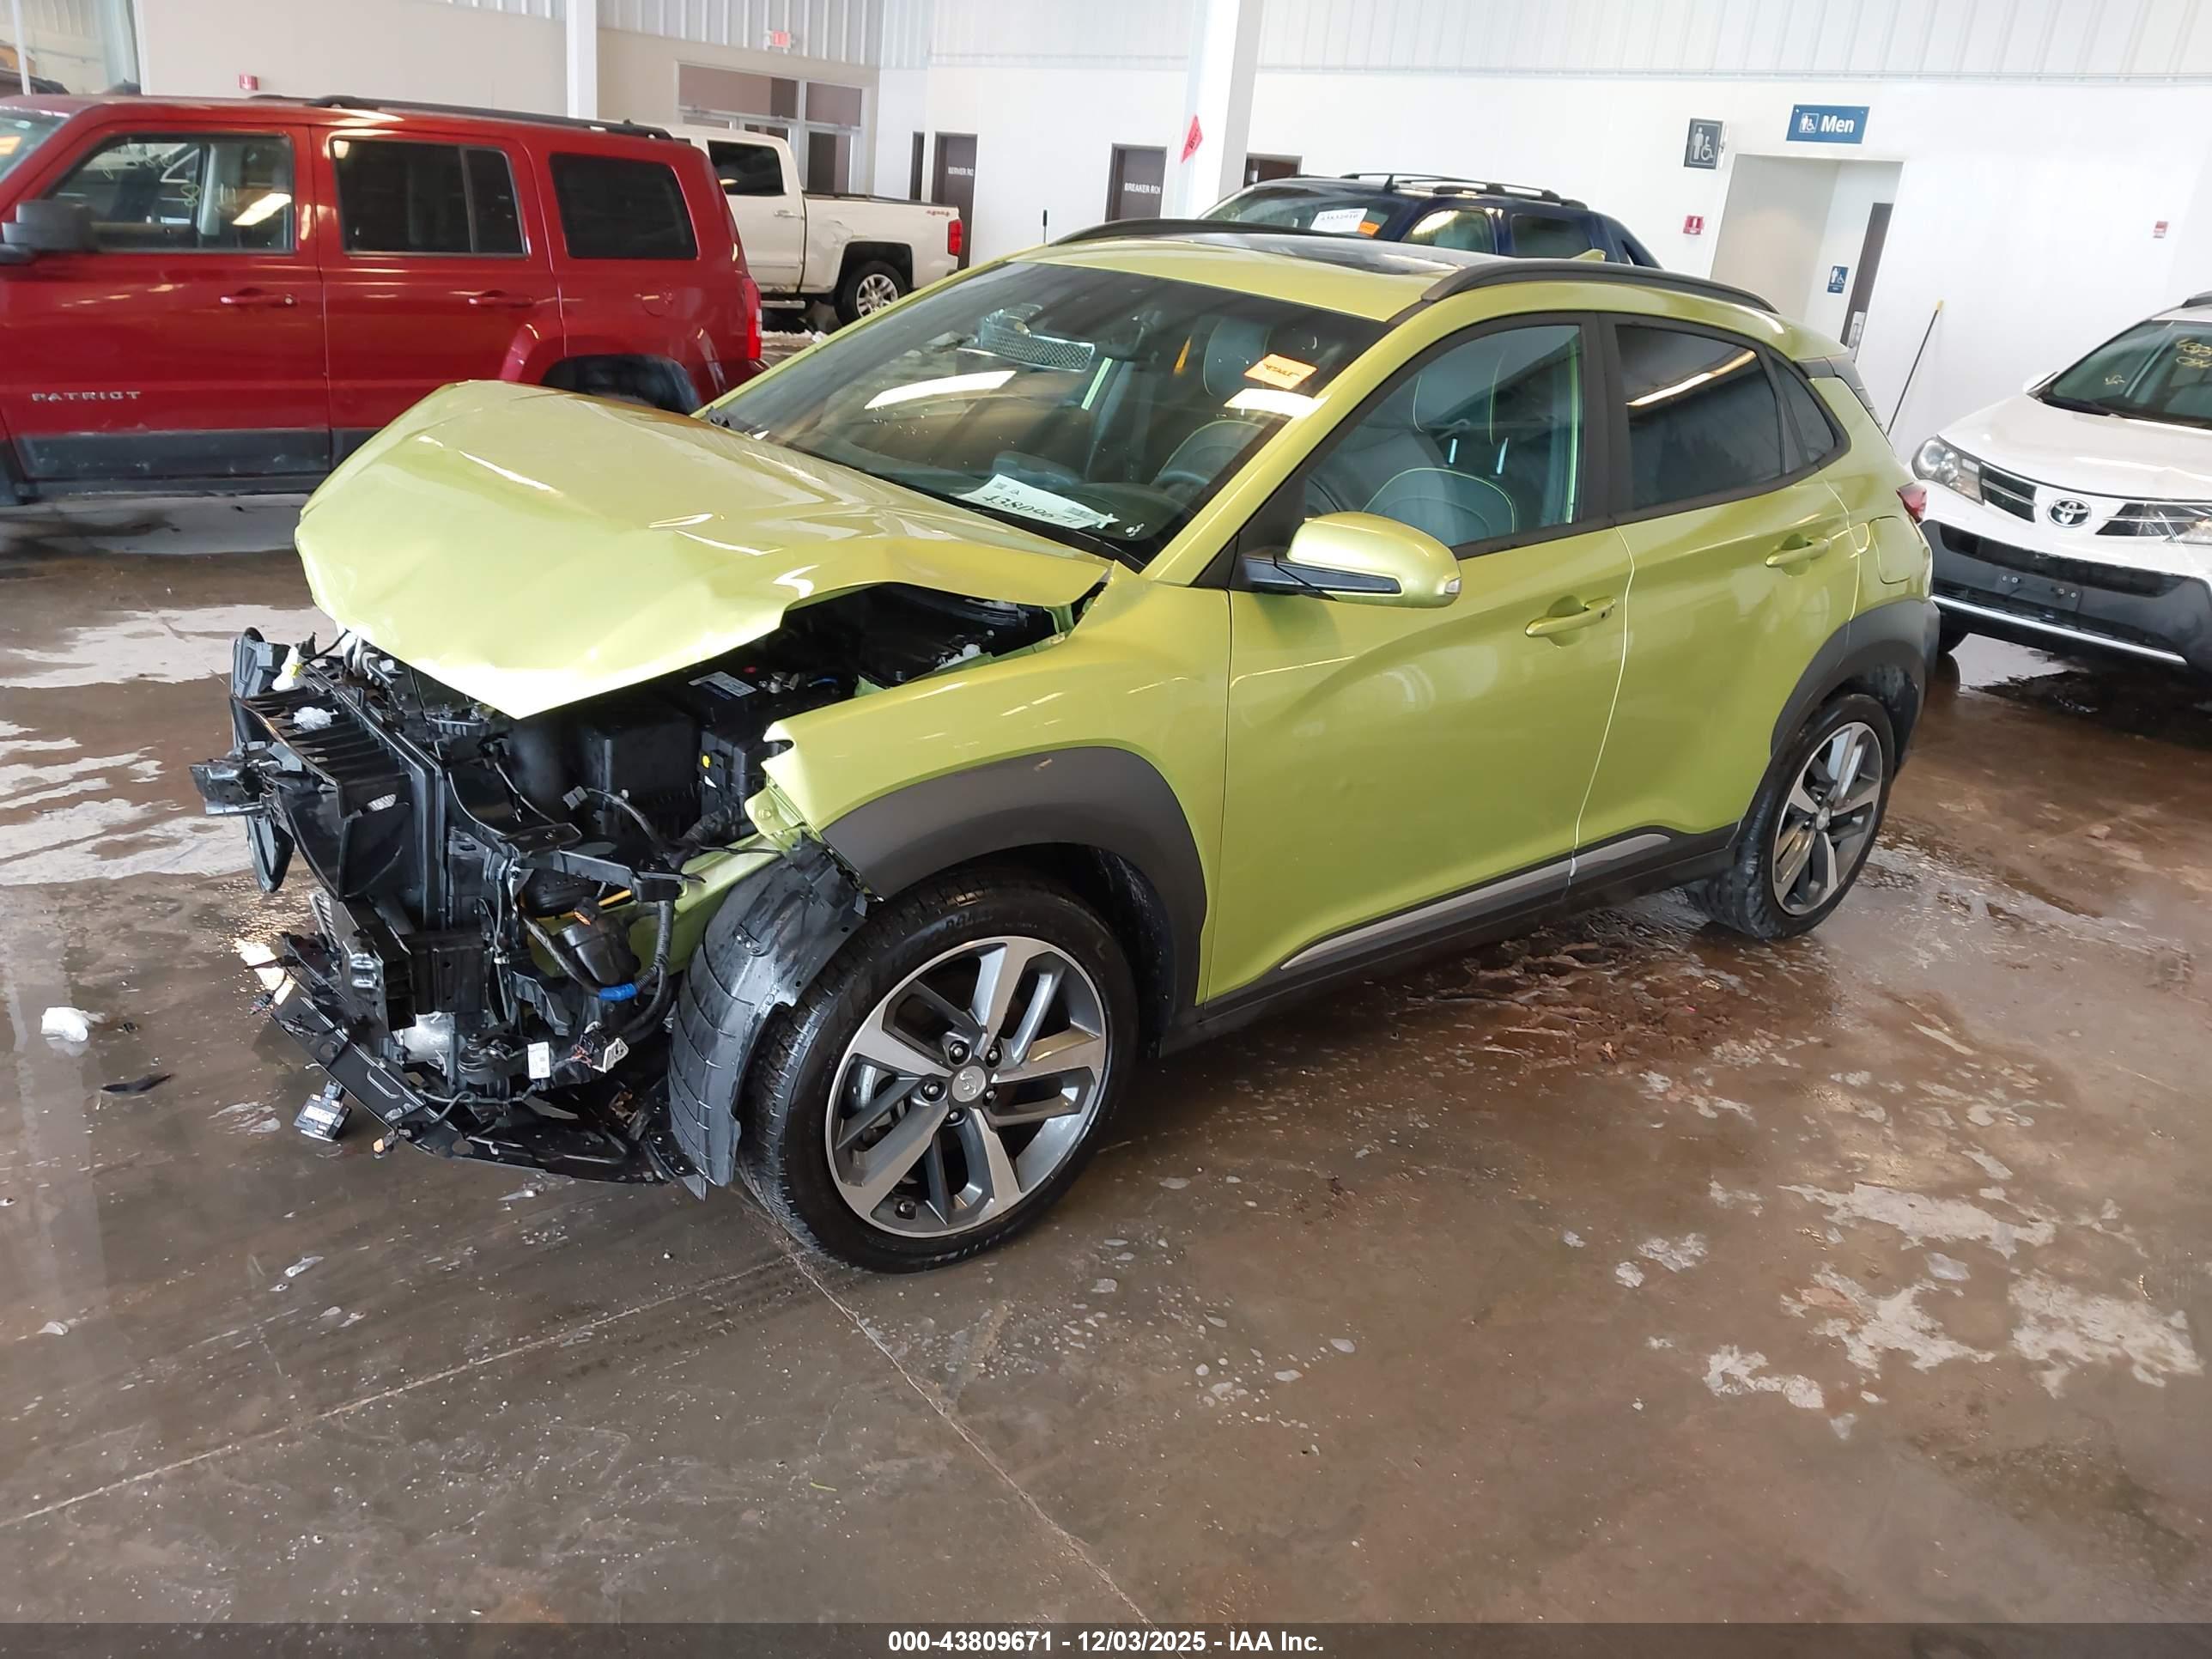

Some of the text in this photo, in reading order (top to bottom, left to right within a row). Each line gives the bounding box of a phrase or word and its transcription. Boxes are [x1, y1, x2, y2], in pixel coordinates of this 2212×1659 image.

[1820, 114, 1855, 132] Men
[1124, 182, 1151, 193] BREAKER
[31, 391, 142, 402] PATRIOT
